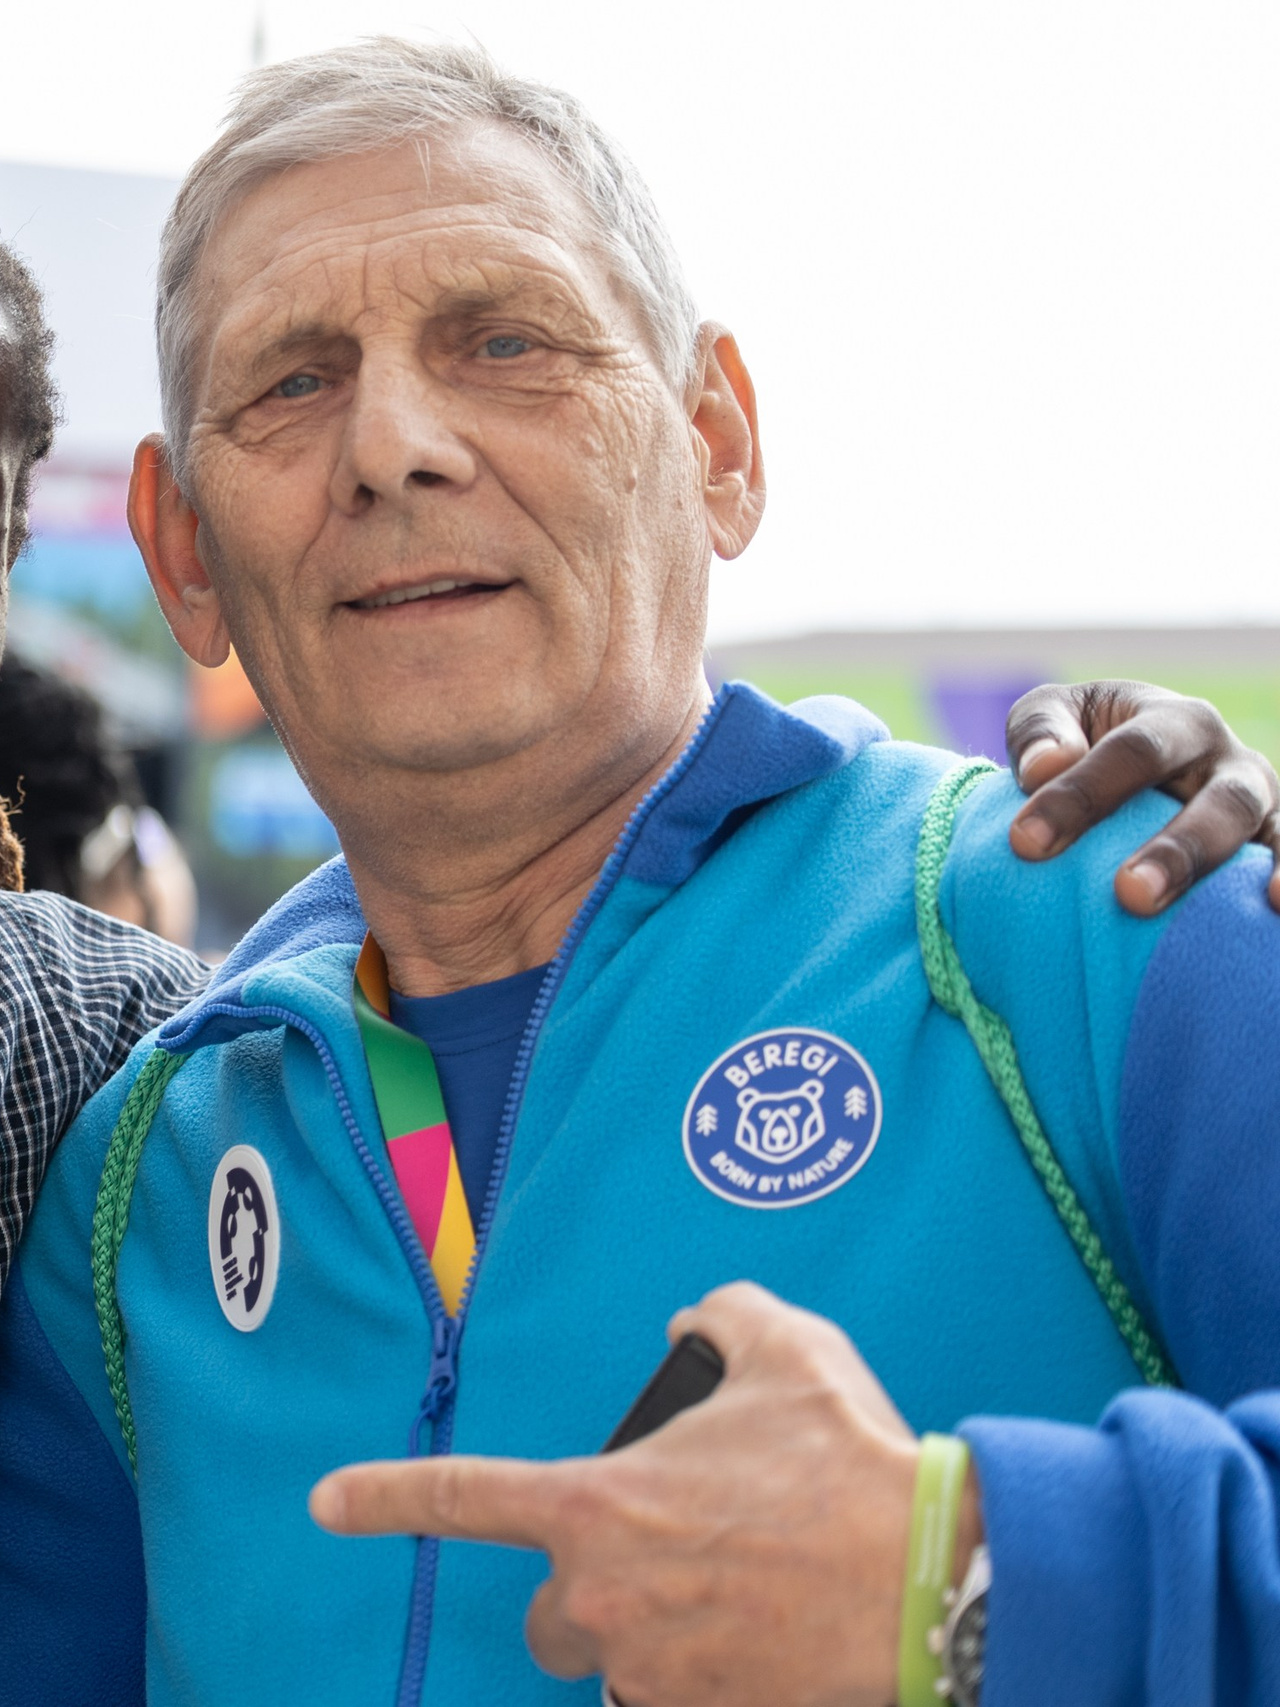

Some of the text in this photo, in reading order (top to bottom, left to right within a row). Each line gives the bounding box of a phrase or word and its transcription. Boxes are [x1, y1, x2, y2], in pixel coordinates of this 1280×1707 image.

[724, 1041, 838, 1088] BEREGI
[710, 1137, 854, 1193] BORN BY NATURE
